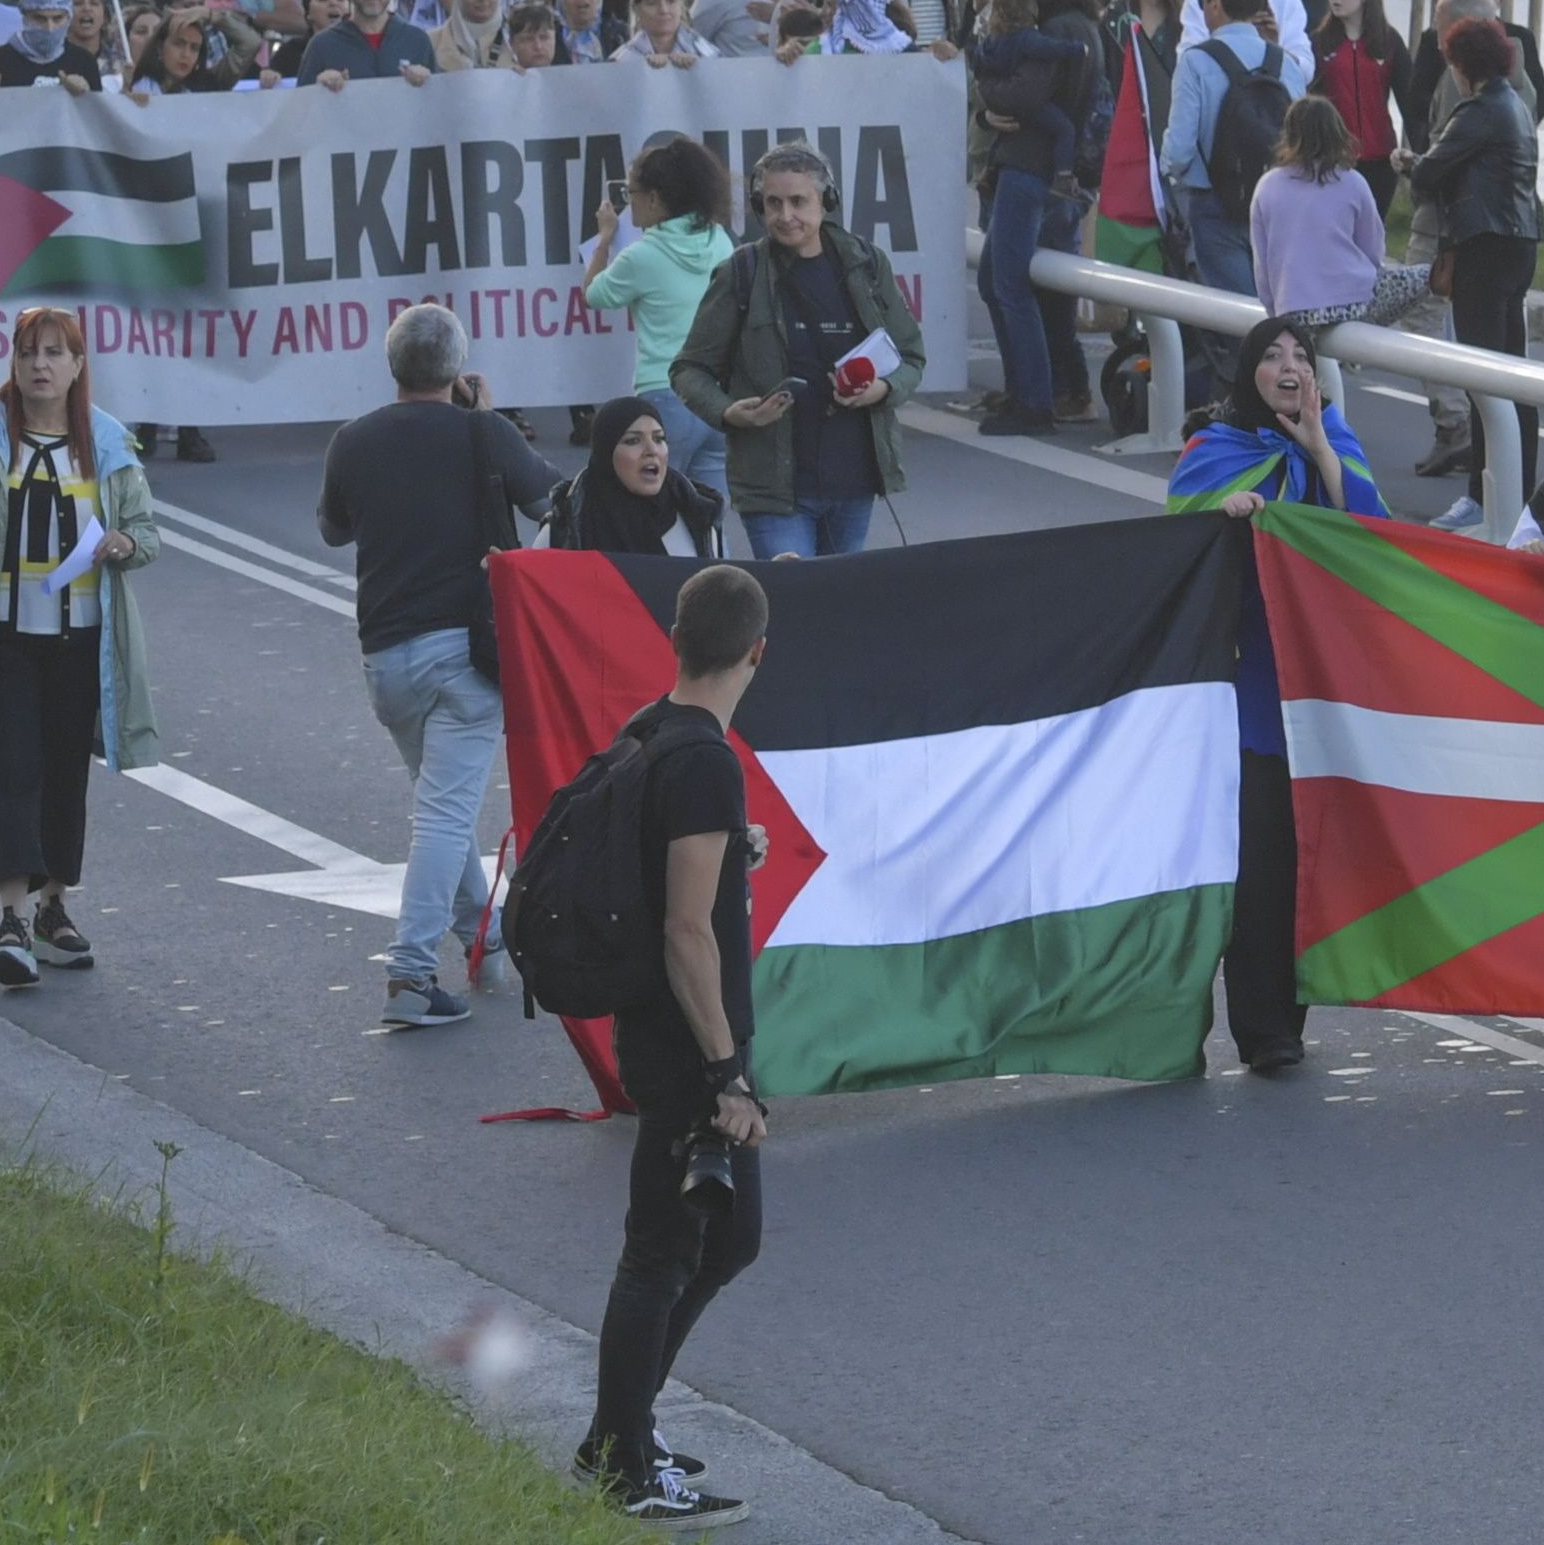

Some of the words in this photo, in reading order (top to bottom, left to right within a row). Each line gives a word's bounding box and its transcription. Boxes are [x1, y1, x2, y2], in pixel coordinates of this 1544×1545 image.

[227, 125, 918, 288] ELKARTAUNA
[272, 302, 367, 355] AND
[388, 286, 612, 340] ITICAL
